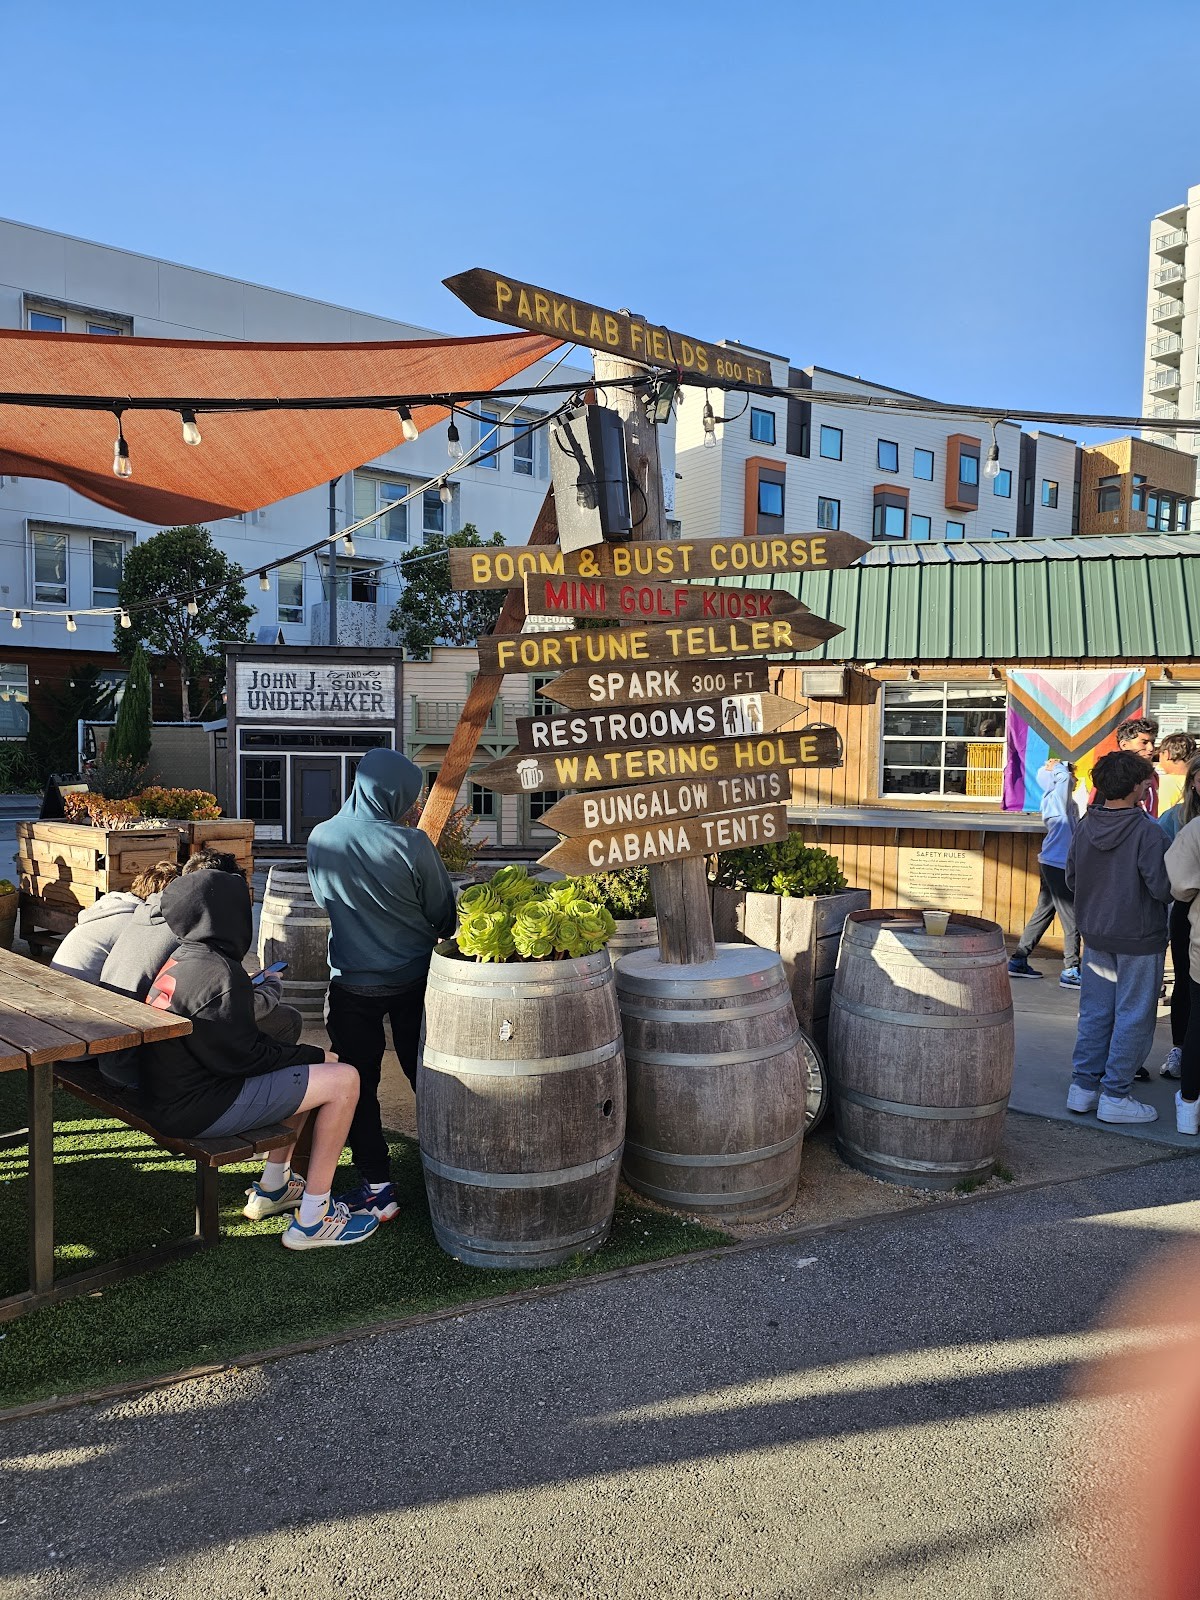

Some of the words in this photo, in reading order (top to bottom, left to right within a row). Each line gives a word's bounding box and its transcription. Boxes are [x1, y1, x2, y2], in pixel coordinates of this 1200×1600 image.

[496, 280, 620, 346] PARKLAB
[630, 323, 709, 372] FIELDS
[716, 358, 742, 381] 800
[746, 366, 762, 386] FT
[471, 551, 565, 584] BOOM
[578, 549, 602, 577] &
[613, 545, 694, 577] BUST
[710, 537, 828, 571] COURSE
[544, 580, 606, 612] MINI
[620, 585, 689, 617] GOLF
[702, 591, 773, 618] KIOSK
[497, 632, 650, 669] FORTUNE
[665, 620, 793, 656] TELLER
[247, 671, 297, 690] JOHN
[305, 671, 321, 691] J.
[331, 680, 383, 691] SONS
[346, 671, 362, 679] AND
[588, 669, 682, 702] SPARK
[691, 675, 726, 693] 300
[734, 671, 755, 691] FT
[247, 690, 386, 713] UNDERTAKER
[531, 705, 717, 748] RESTROOMS
[554, 745, 719, 784] WATERING
[734, 735, 820, 769] HOLE
[583, 783, 708, 829] BUNGALOW
[717, 773, 782, 805] TENTS
[588, 826, 691, 867] CABANA
[701, 812, 777, 848] TENTS
